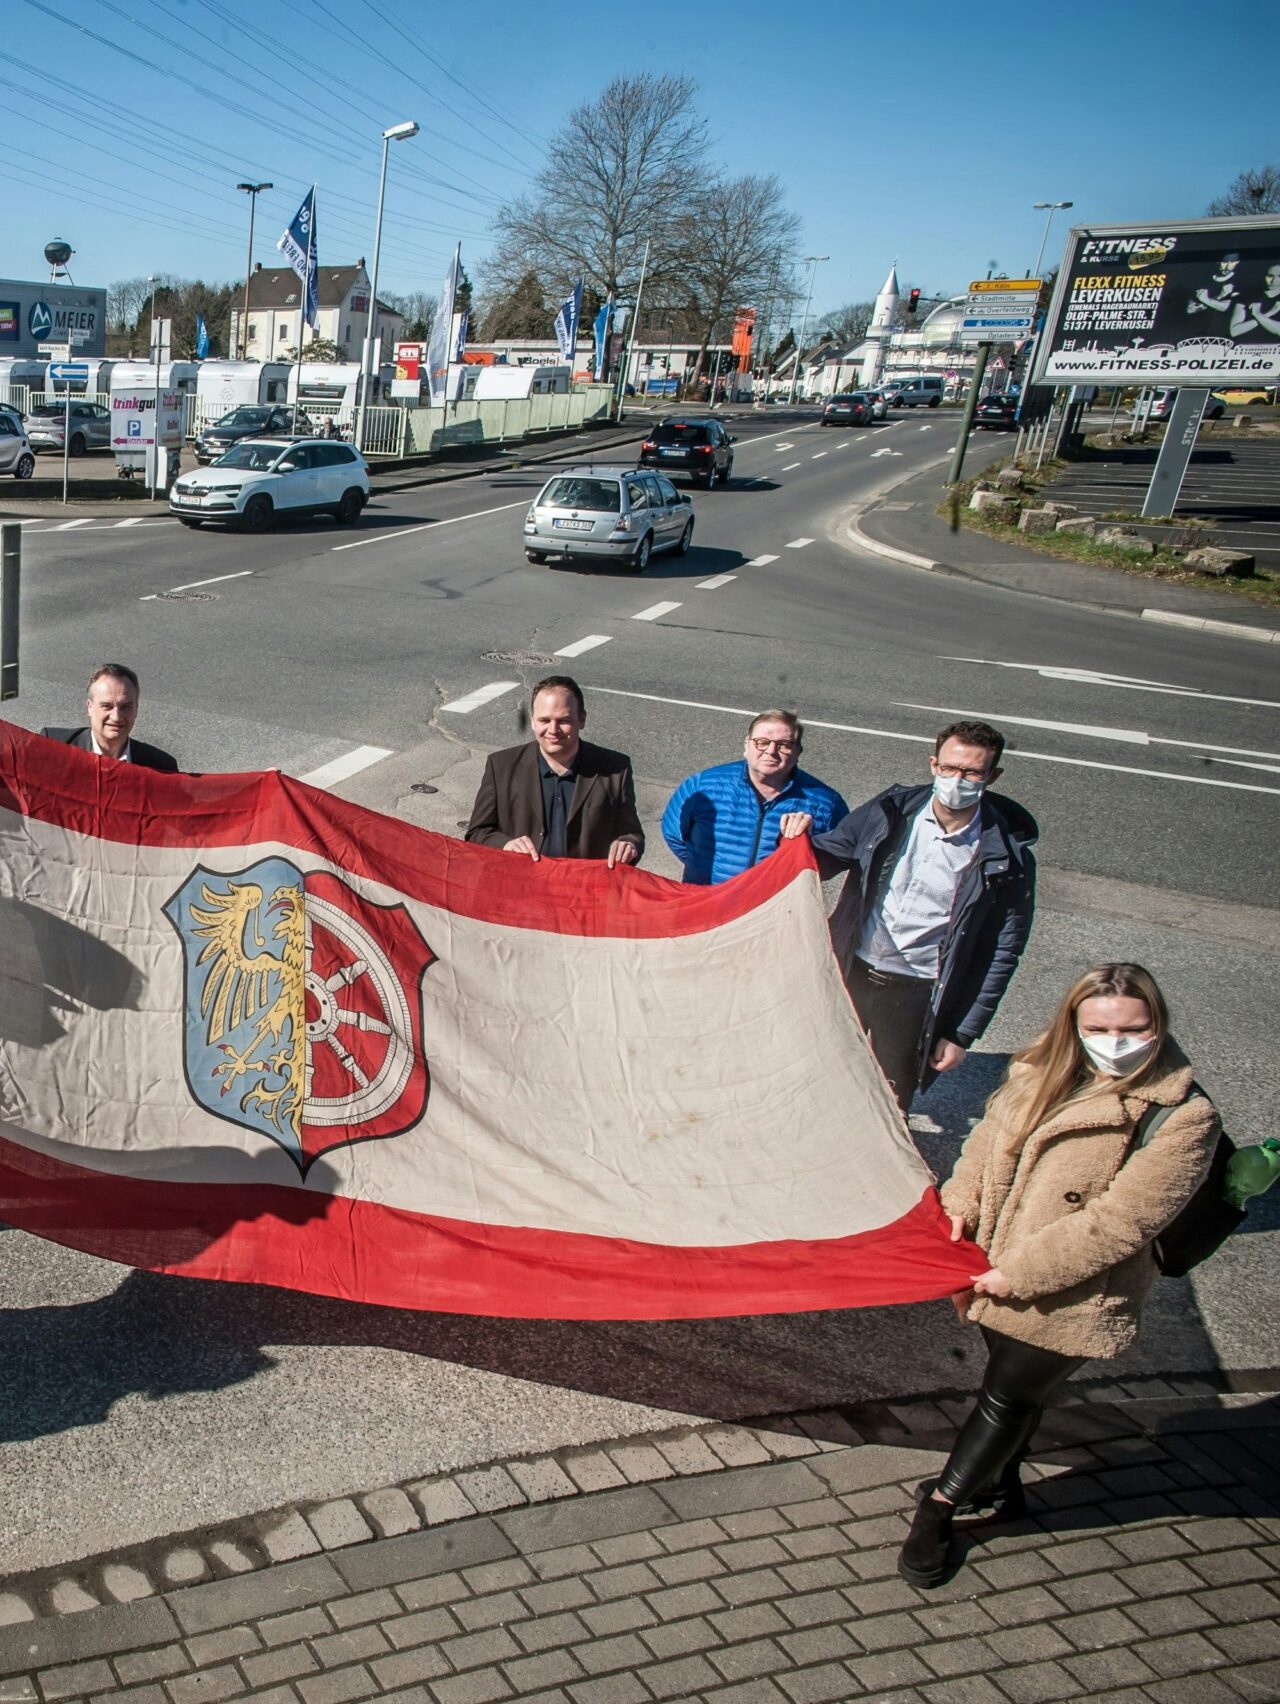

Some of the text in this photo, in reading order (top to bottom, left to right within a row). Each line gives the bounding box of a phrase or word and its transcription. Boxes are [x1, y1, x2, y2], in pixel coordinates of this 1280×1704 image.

[1083, 237, 1178, 255] FITNESS
[1089, 255, 1119, 263] KURSE
[1074, 274, 1166, 289] FLEXX FITNESS
[1070, 287, 1163, 303] LEVERKUSEN
[1101, 302, 1159, 311] HAGEBAUMARKT)
[54, 311, 95, 329] MEIER
[1065, 310, 1157, 321] OLOF-PALME-STR. 1
[1063, 319, 1154, 331] 51371 LEVERKUSEN
[1054, 359, 1274, 371] www.FITNESS-POLIZEI.de
